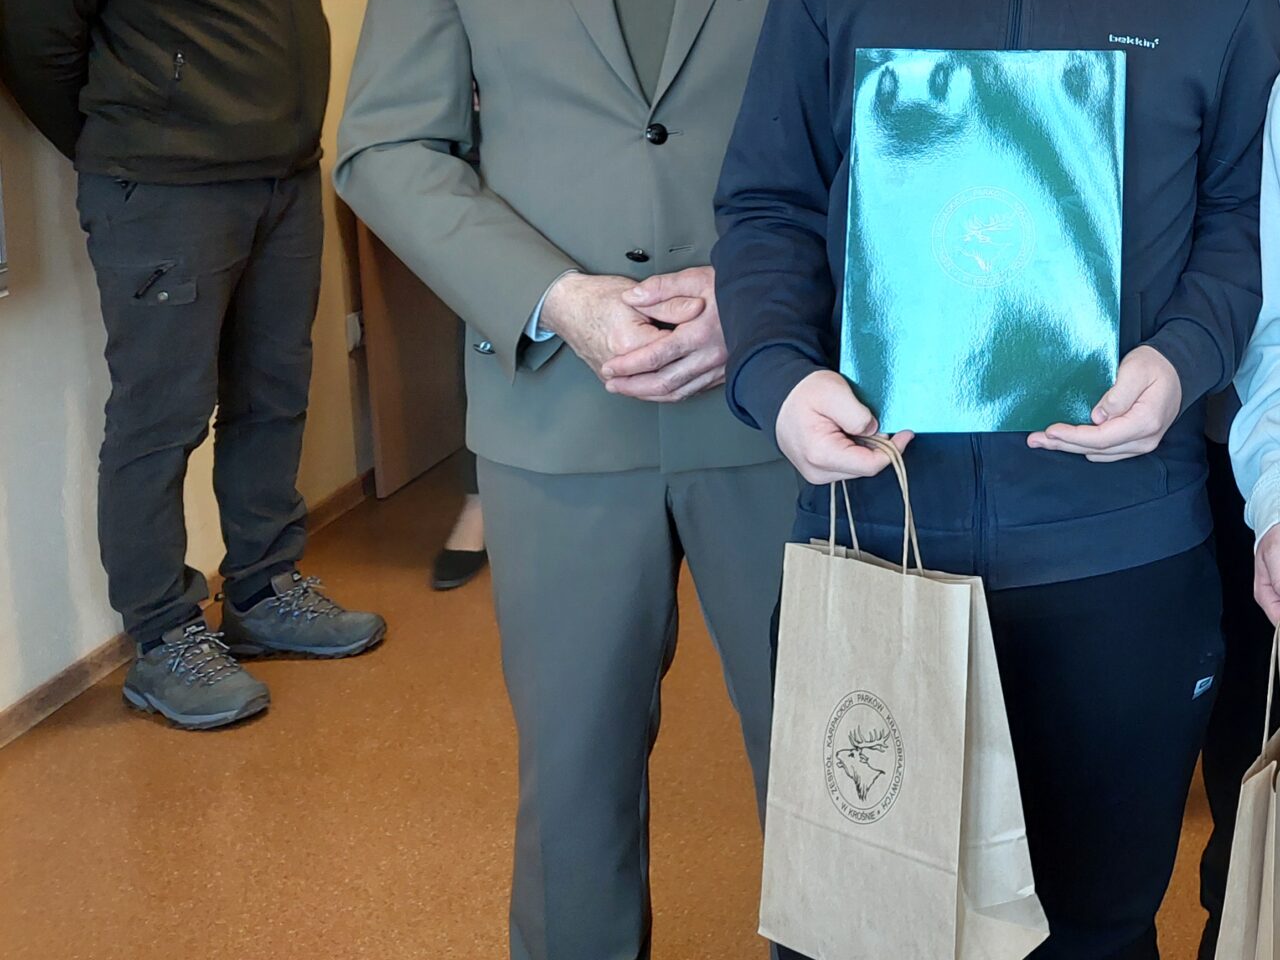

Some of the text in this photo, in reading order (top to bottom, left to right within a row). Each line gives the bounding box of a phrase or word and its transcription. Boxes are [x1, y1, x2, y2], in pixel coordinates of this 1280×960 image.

[827, 697, 854, 748] KARPACKICH
[857, 694, 884, 711] PARKÓW
[882, 714, 903, 811] KRAJOBRAZOWYCH
[840, 803, 877, 821] W KROŚNIE
